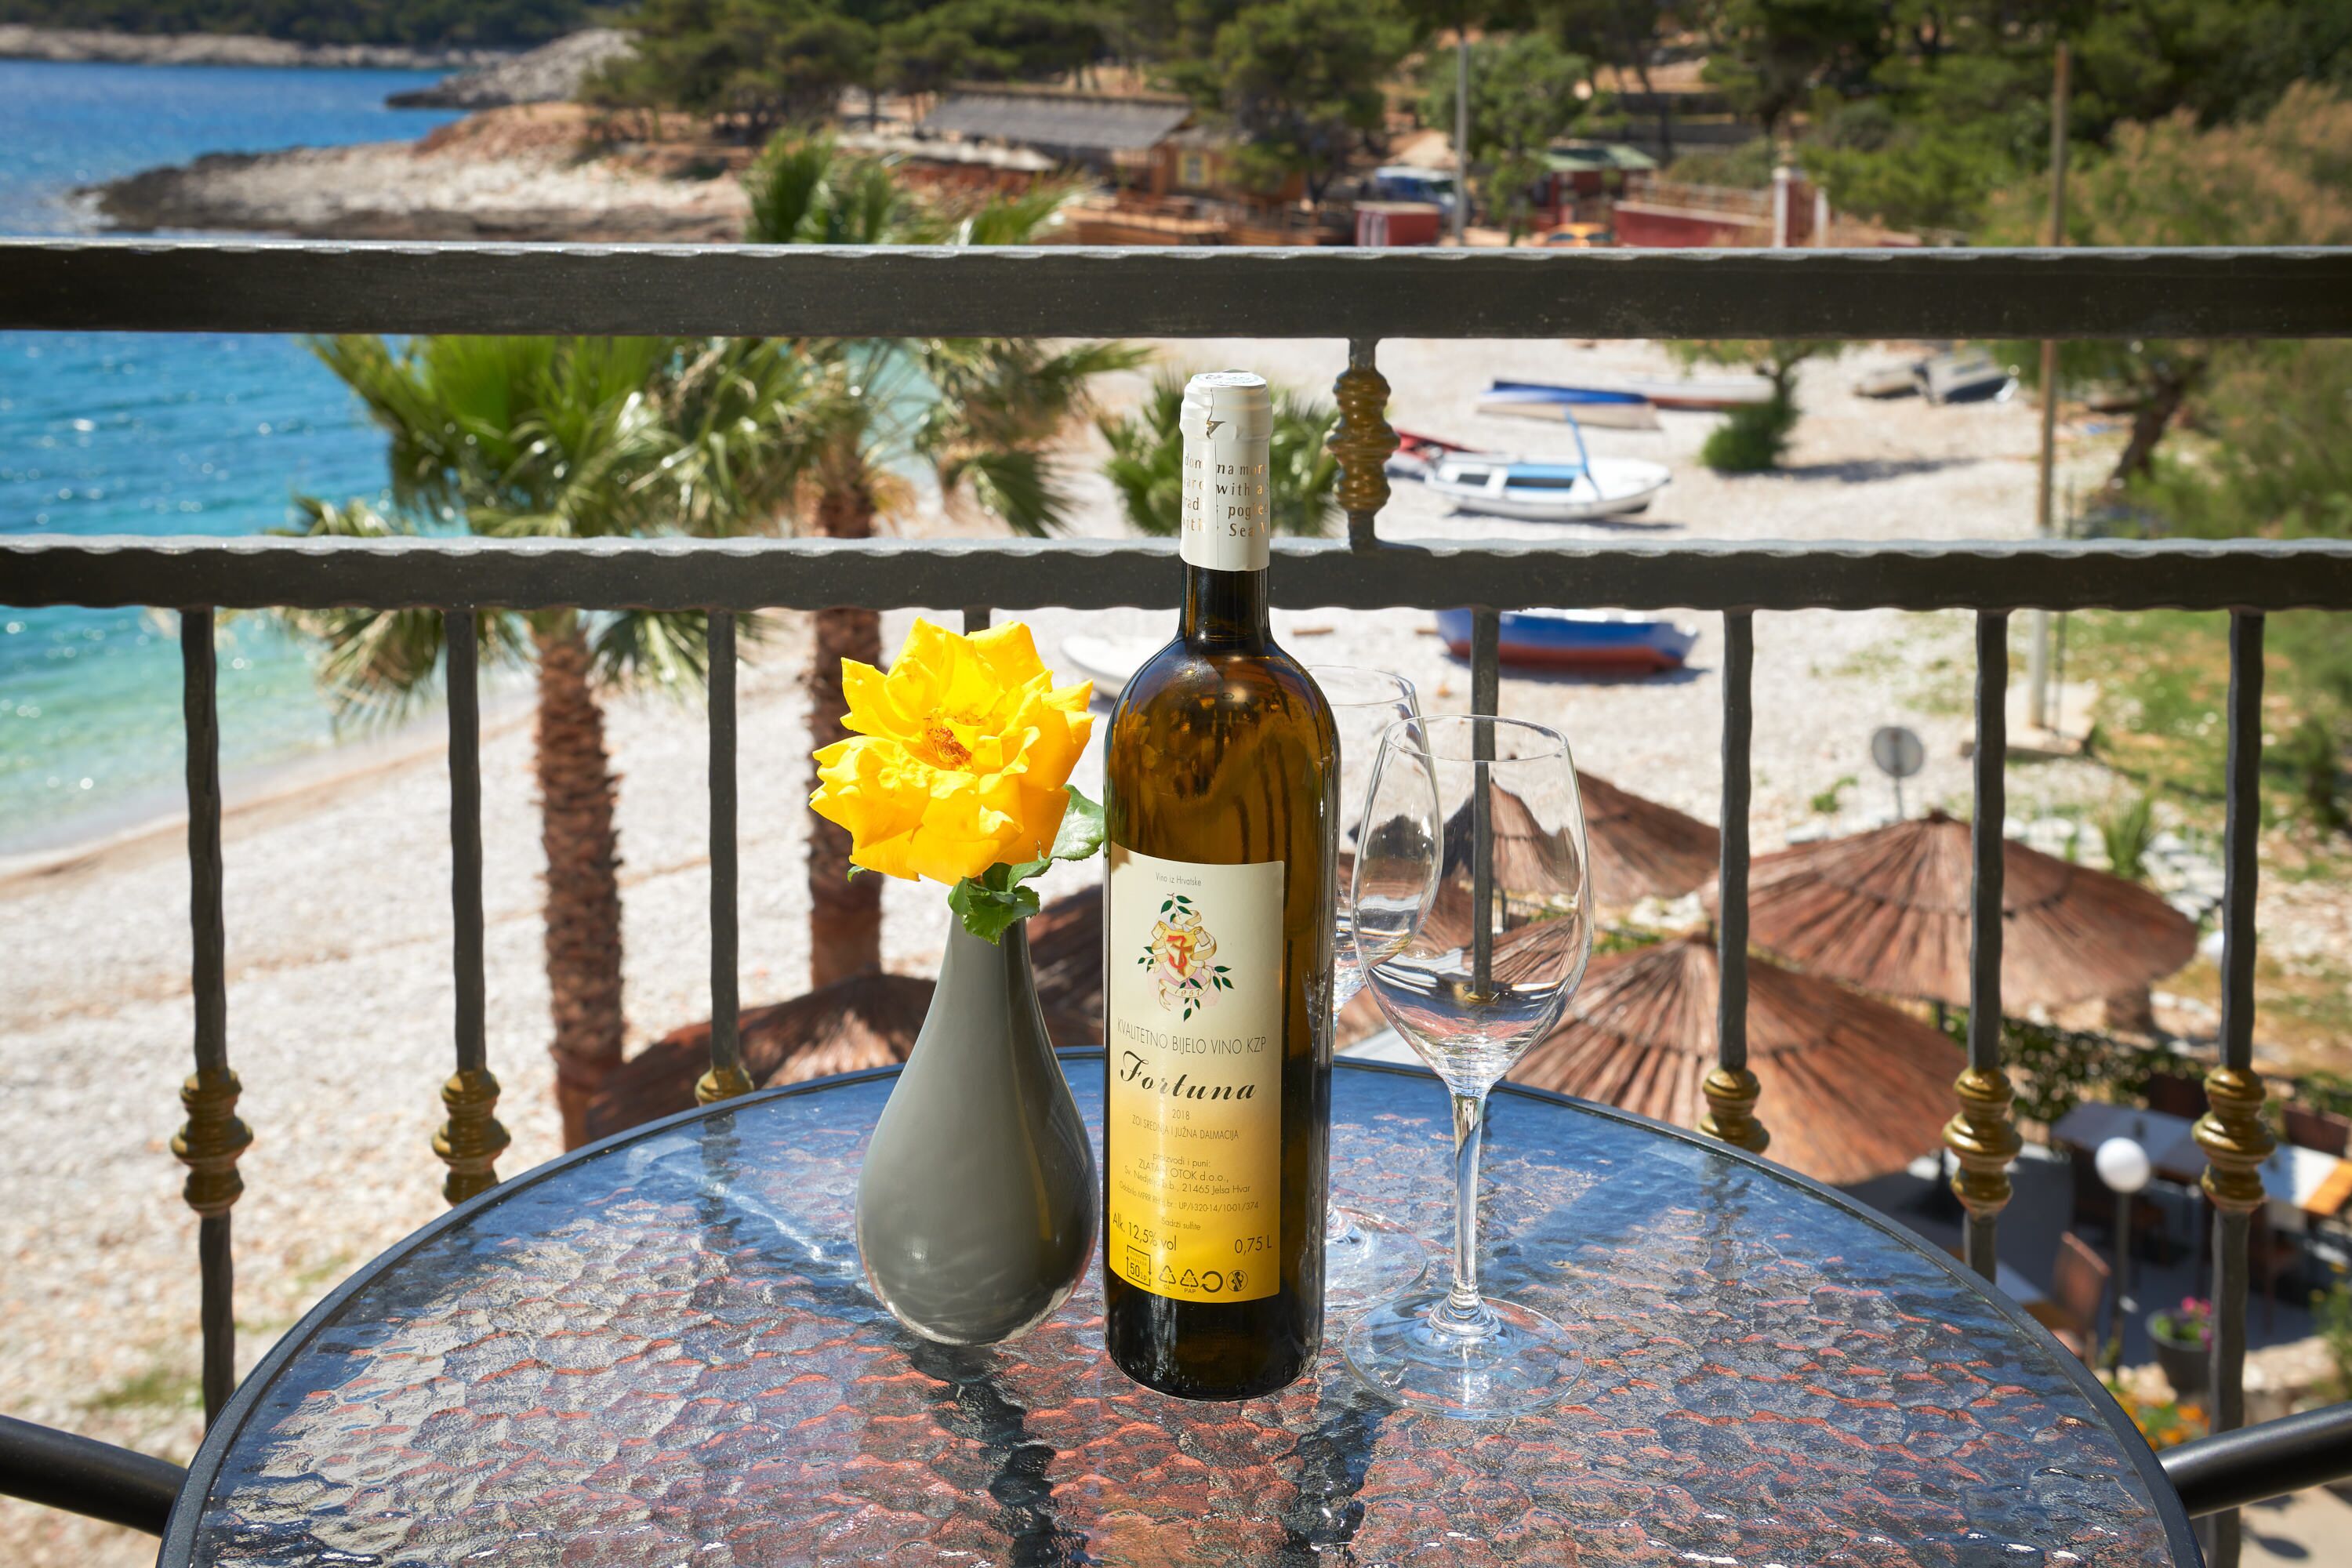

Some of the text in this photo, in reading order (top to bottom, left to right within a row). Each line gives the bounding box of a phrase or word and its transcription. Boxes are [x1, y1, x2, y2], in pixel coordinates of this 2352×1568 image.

[1217, 463, 1234, 475] na
[1216, 482, 1250, 496] with
[1256, 485, 1264, 495] a
[1229, 522, 1255, 538] Sea
[1155, 871, 1167, 883] Vino
[1176, 875, 1202, 887] Hrvatske
[1117, 1017, 1267, 1055] KVALITETNO BIJELO VINO KZP
[1120, 1050, 1257, 1101] Fortuna
[1172, 1109, 1189, 1120] 2018
[1132, 1115, 1142, 1125] ZOI
[1143, 1119, 1170, 1135] SREDNJA
[1174, 1126, 1198, 1139] JUŽNA
[1200, 1129, 1240, 1142] DALMACIJA
[1192, 1160, 1211, 1169] puni:
[1170, 1167, 1197, 1180] OTOK
[1181, 1182, 1210, 1194] 21465
[1211, 1185, 1230, 1196] Jelsa
[1232, 1184, 1250, 1193] Hvar
[1112, 1212, 1272, 1256] Alk. 12,5% vol 0,75 L
[1130, 1261, 1140, 1277] 50
